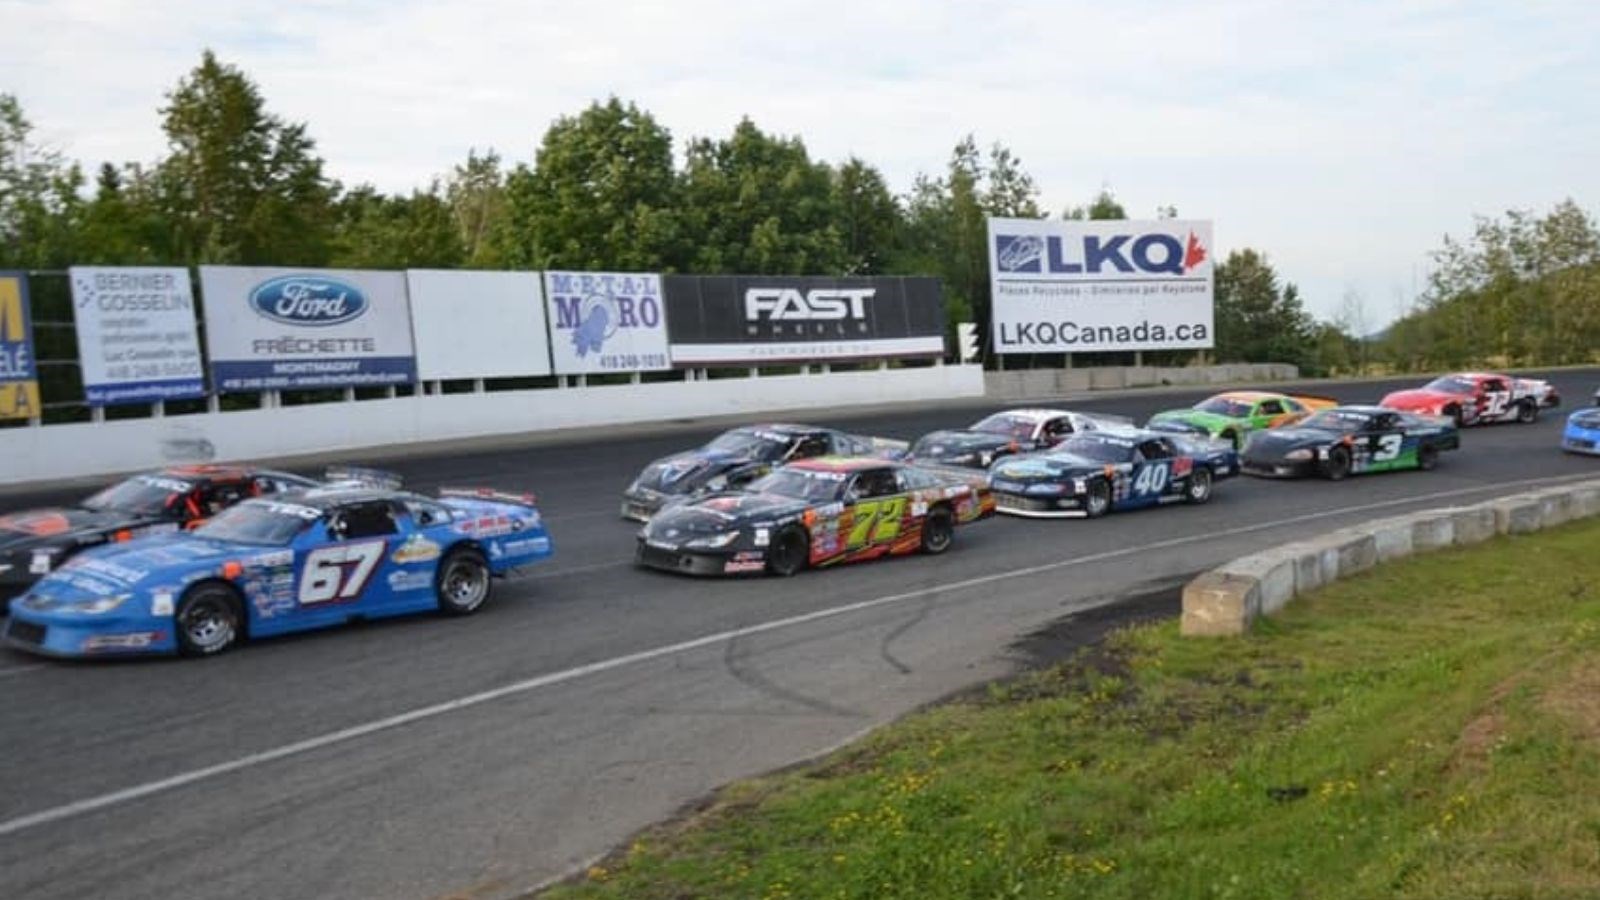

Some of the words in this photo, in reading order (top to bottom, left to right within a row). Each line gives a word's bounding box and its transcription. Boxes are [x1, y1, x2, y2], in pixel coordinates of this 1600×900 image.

[1047, 234, 1185, 275] LKQ
[95, 272, 175, 291] BERNIER
[98, 294, 188, 311] GOSSELIN
[276, 282, 347, 316] Ford
[745, 288, 876, 320] FAST
[253, 336, 375, 354] FRÉCHETTE
[1000, 321, 1208, 345] LKQCanada.ca
[1374, 434, 1403, 461] 3
[1135, 464, 1169, 495] 40
[848, 498, 907, 546] 72
[298, 540, 387, 604] 67
